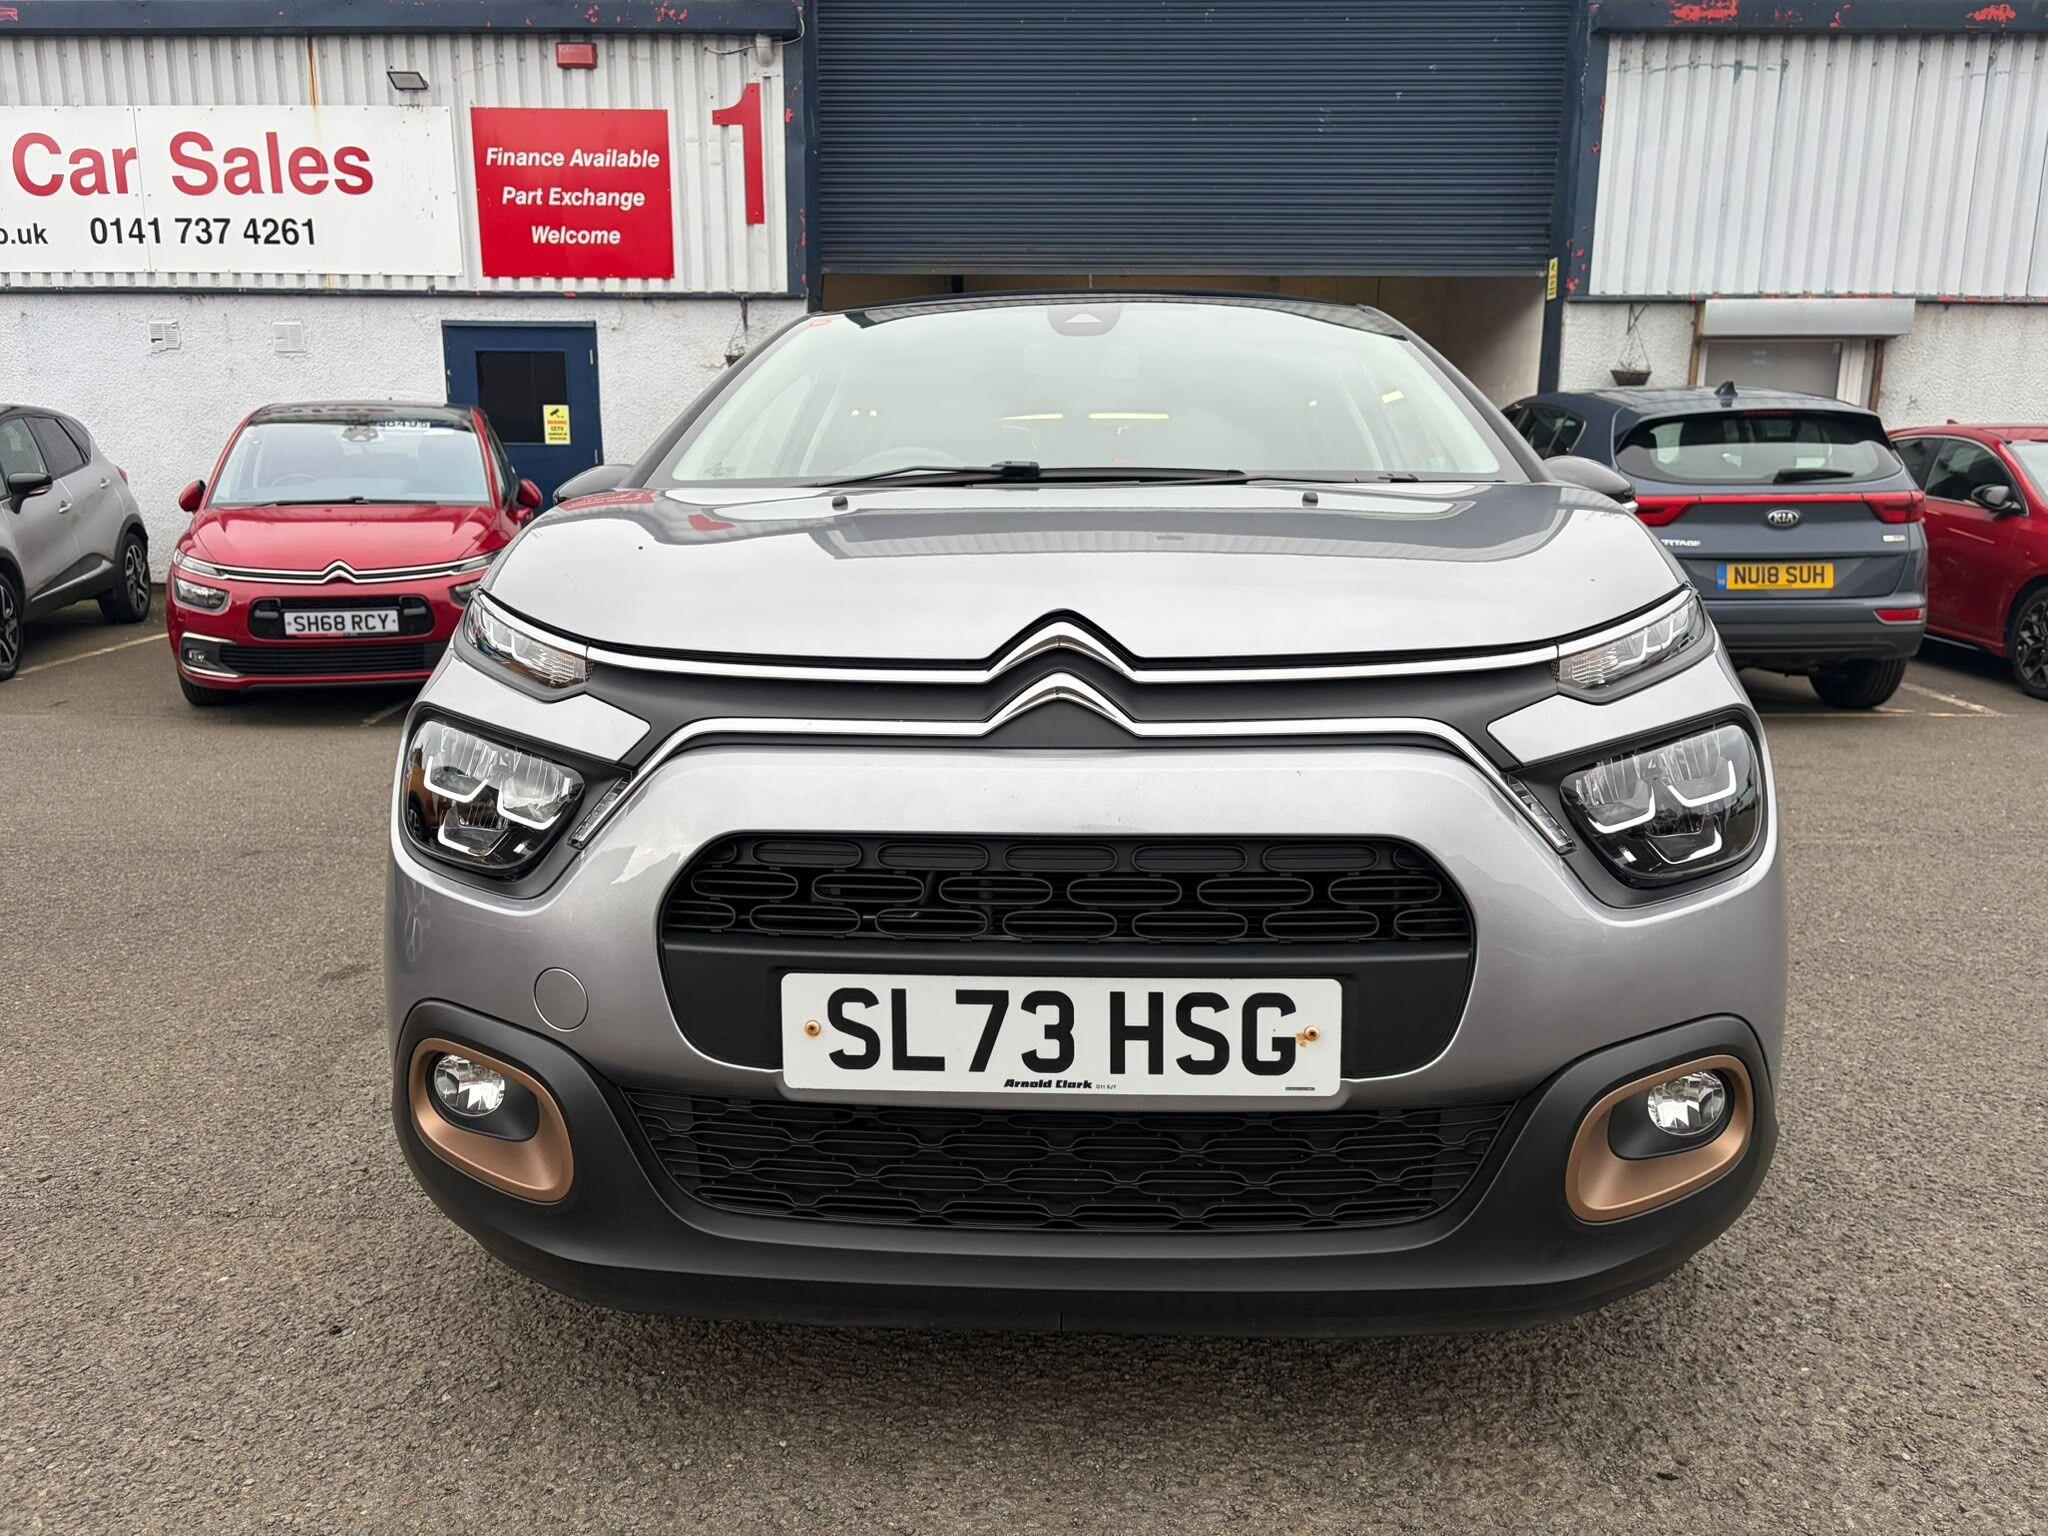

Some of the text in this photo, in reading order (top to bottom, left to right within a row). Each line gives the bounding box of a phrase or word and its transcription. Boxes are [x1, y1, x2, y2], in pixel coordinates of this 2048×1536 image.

[12, 131, 374, 196] Car Sales
[486, 146, 660, 169] Finance Available
[712, 82, 765, 225] 1
[502, 186, 645, 211] Part Exchange
[90, 217, 161, 245] 0141
[174, 217, 231, 245] 737
[243, 217, 315, 246] 4261
[531, 226, 621, 245] Welcome
[1734, 564, 1826, 585] NU18 SUH
[293, 613, 389, 632] SH68 RCY
[826, 986, 1298, 1077] SL73 HSG
[1003, 1078, 1053, 1088] Arnold
[1055, 1079, 1093, 1089] Clark
